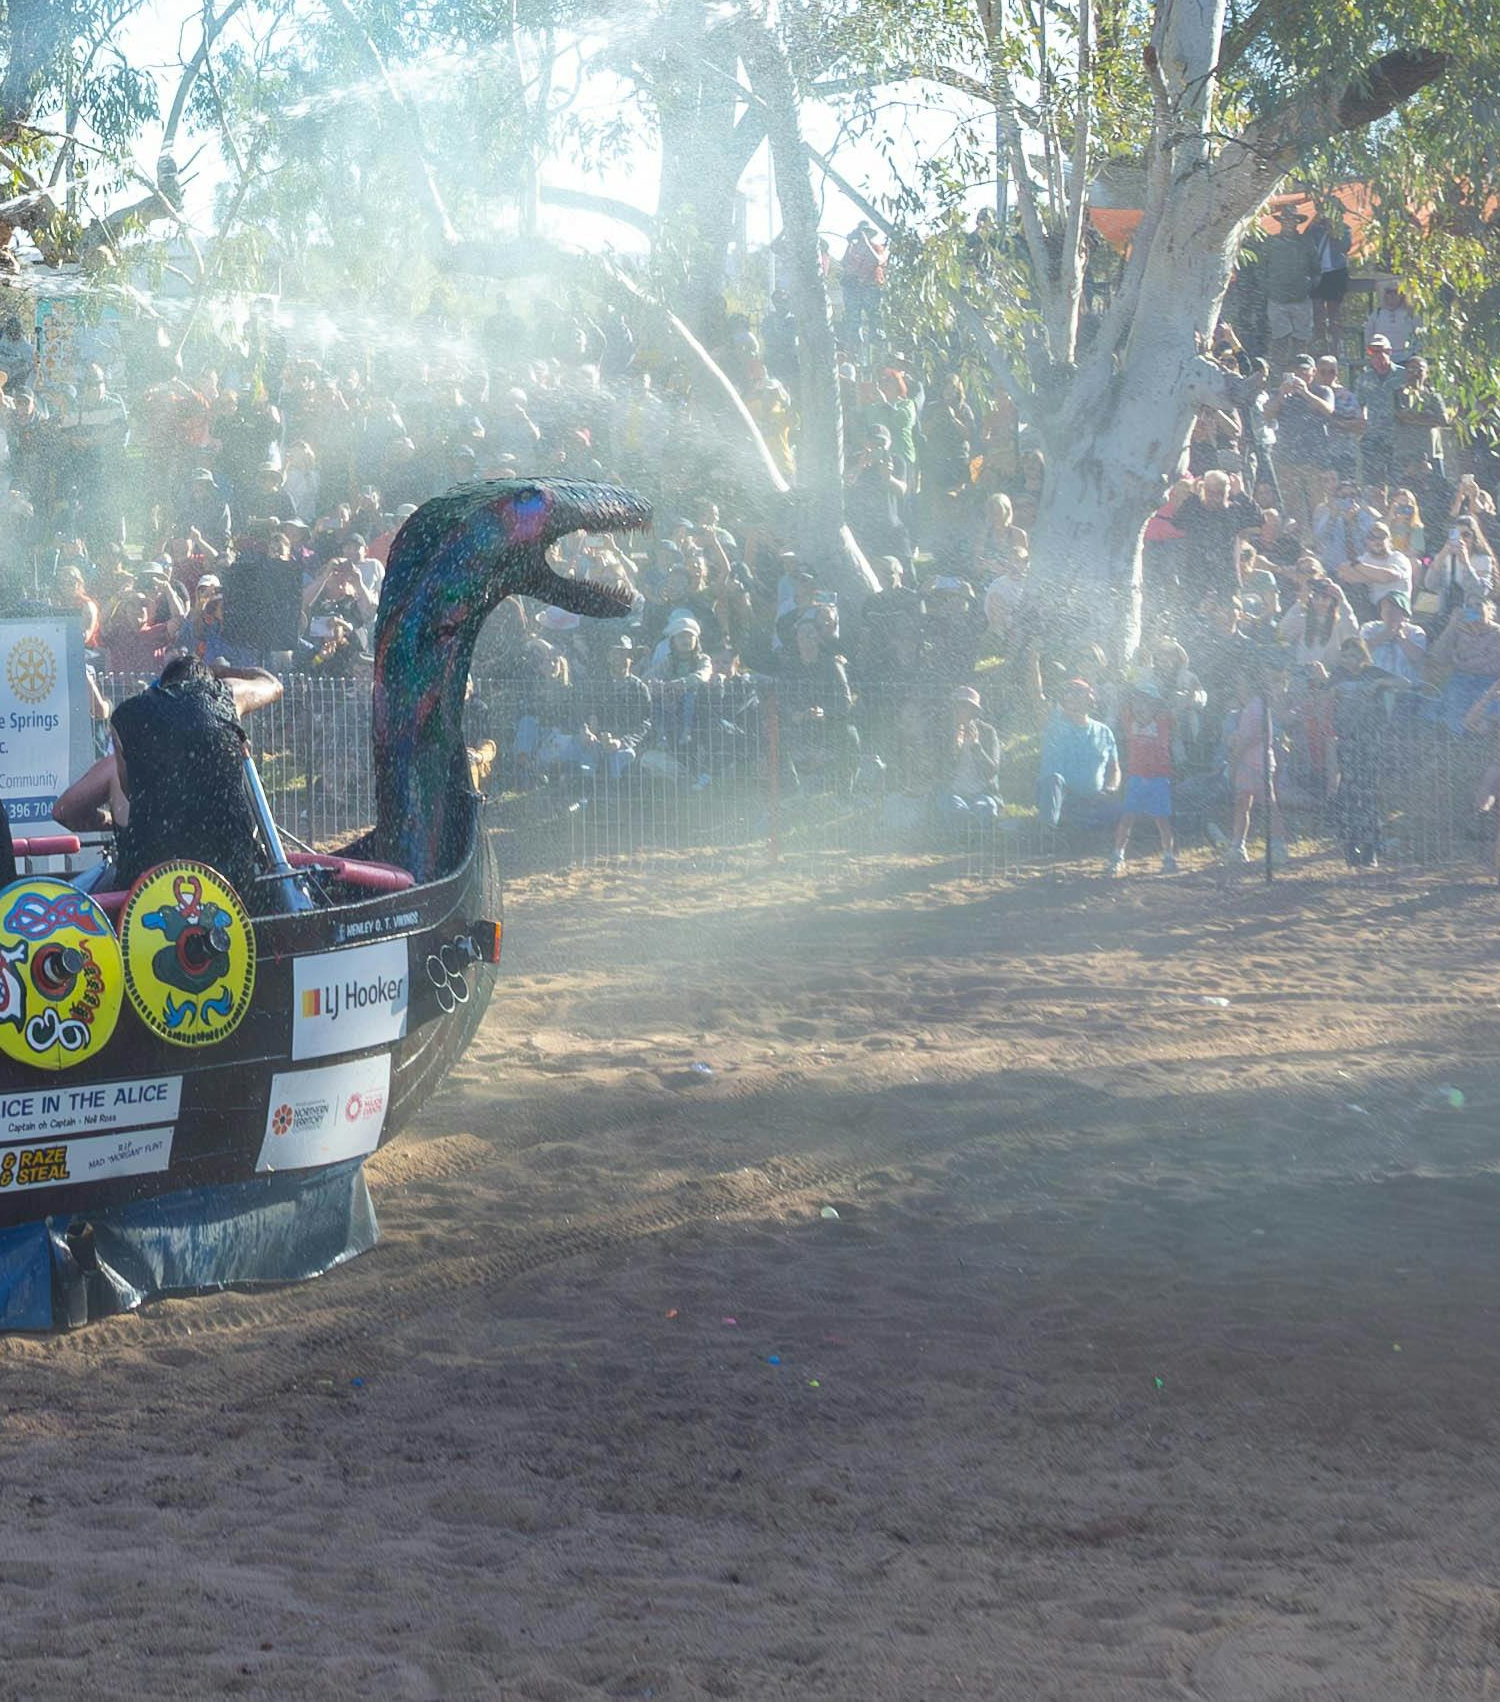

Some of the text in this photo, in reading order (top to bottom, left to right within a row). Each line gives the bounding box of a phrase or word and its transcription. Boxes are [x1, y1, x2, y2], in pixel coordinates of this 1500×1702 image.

[10, 711, 59, 733] Springs
[10, 802, 31, 819] 396
[325, 975, 404, 1020] LJ Hooker
[41, 1095, 60, 1115] IN
[69, 1090, 106, 1111] THE
[113, 1083, 169, 1106] ALICE
[8, 1123, 36, 1134] Captain
[49, 1118, 76, 1130] Captain
[2, 1154, 17, 1171] &
[20, 1146, 68, 1166] RAZE
[0, 1169, 13, 1187] &
[17, 1164, 71, 1185] STEAL
